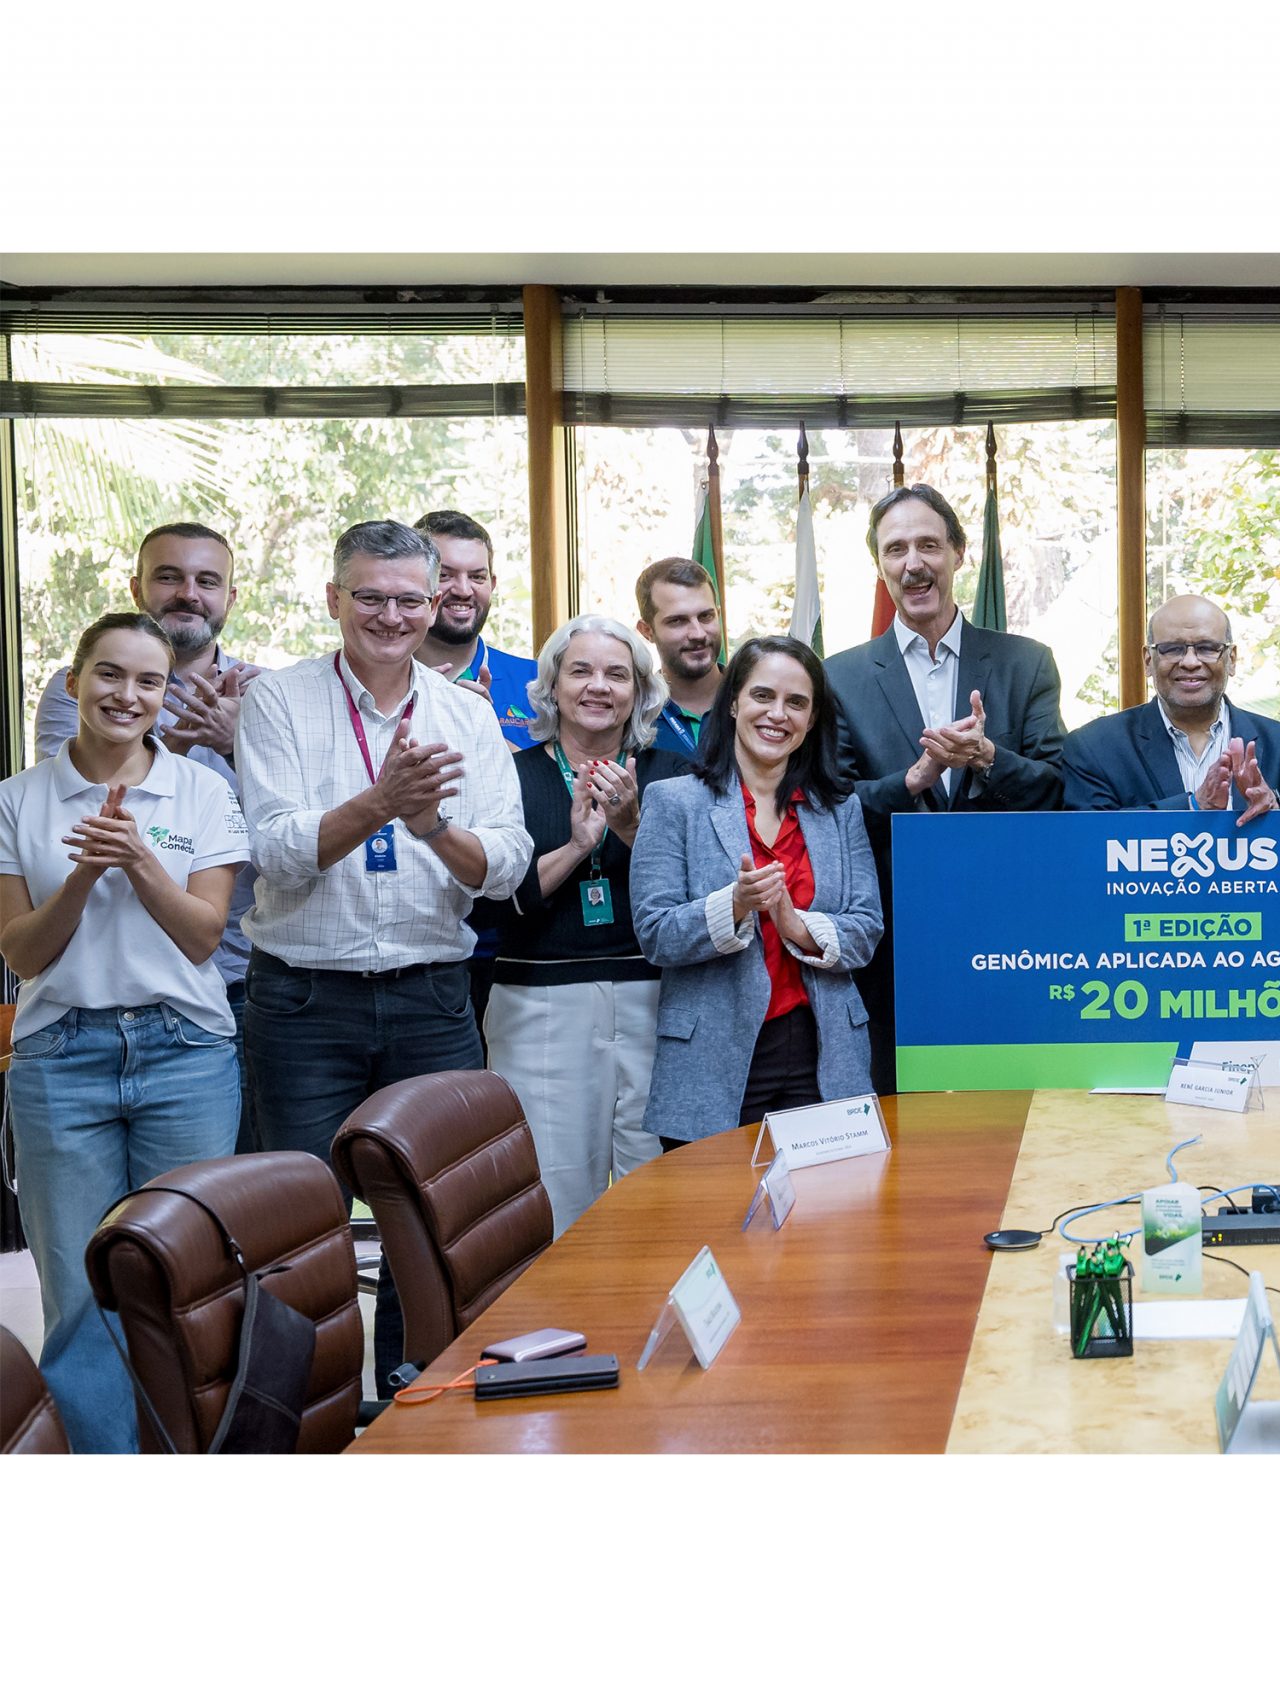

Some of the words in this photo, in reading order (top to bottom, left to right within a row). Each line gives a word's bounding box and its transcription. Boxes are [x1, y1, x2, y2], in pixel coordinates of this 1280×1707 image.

[160, 841, 195, 855] Conecta
[168, 834, 193, 846] Mapa
[1106, 832, 1278, 878] NEXUS
[1106, 879, 1201, 897] INOVAÇÃO
[1207, 880, 1279, 894] ABERTA
[1159, 914, 1253, 940] EDIÇÃO
[971, 950, 1090, 971] GENÔMICA
[1096, 951, 1207, 969] APLICADA
[1212, 951, 1245, 967] AO
[1049, 983, 1076, 1001] R$
[1079, 979, 1149, 1020] 20
[1194, 1085, 1214, 1093] GARCIA
[847, 1106, 864, 1116] BRDE
[791, 1140, 819, 1151] MARCOS
[818, 1134, 845, 1146] VITÓRIO
[845, 1129, 869, 1141] STAMM
